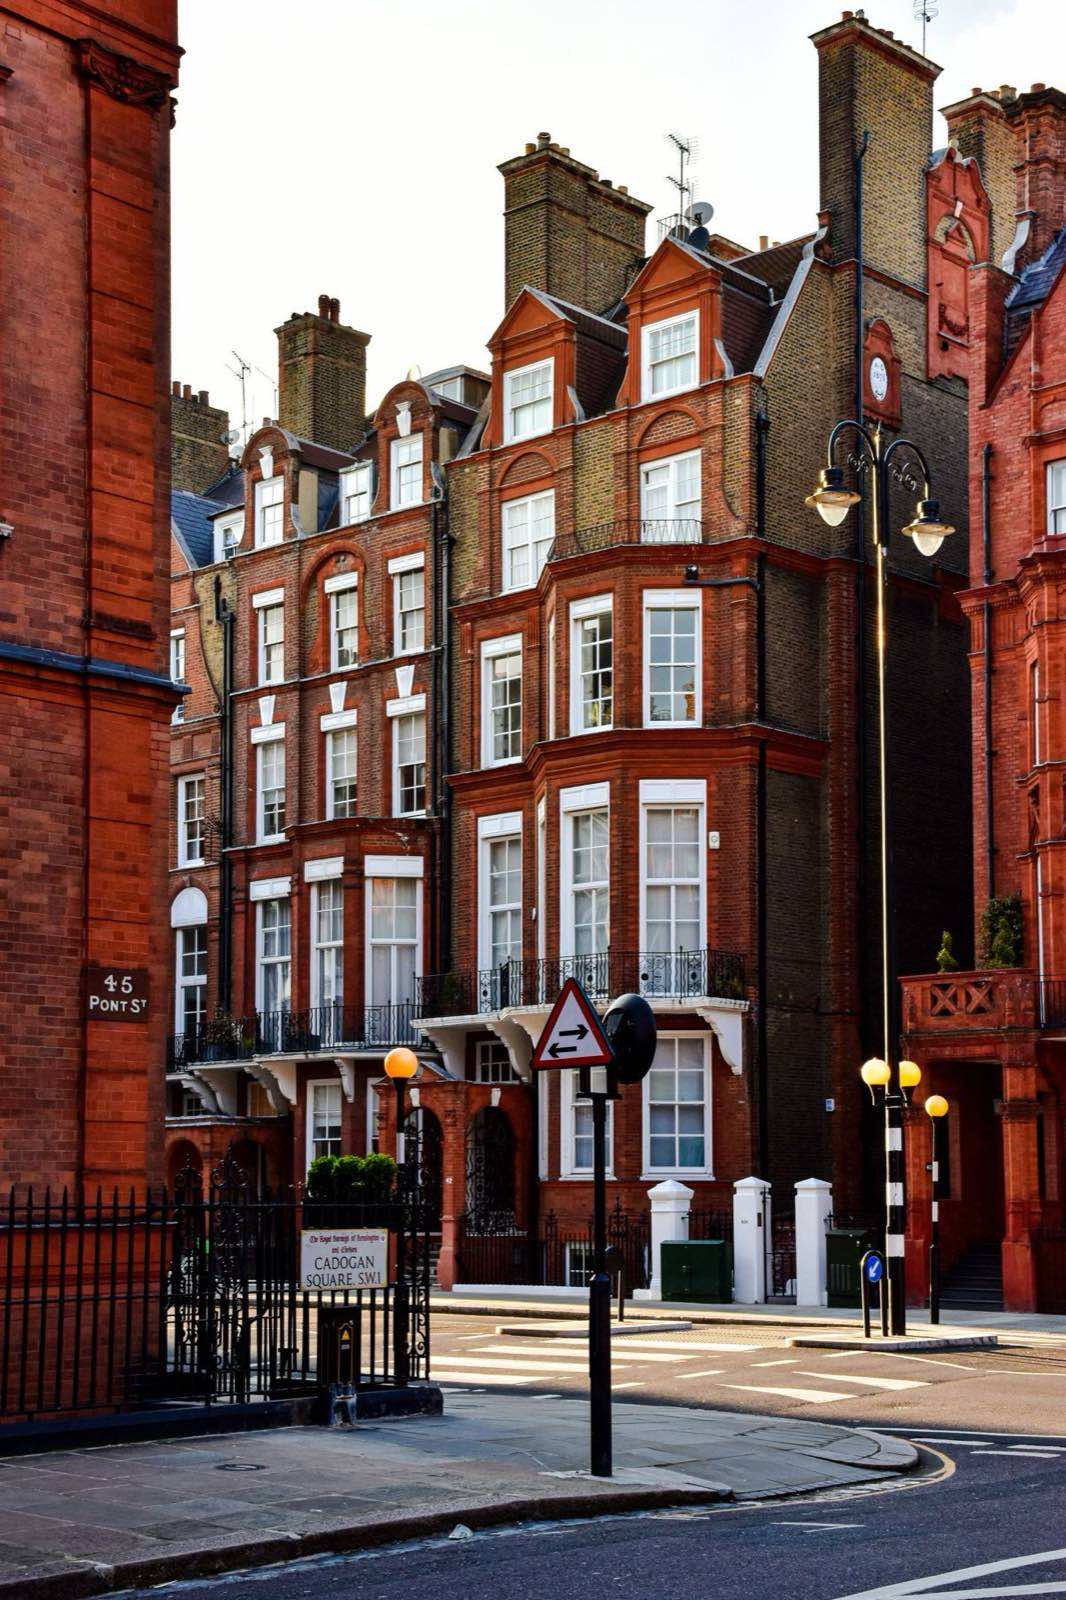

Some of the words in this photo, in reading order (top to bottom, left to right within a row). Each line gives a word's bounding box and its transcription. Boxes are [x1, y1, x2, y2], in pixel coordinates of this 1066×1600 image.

[104, 974, 133, 994] 45
[89, 995, 128, 1012] PONT
[314, 1255, 375, 1270] CADOGAN
